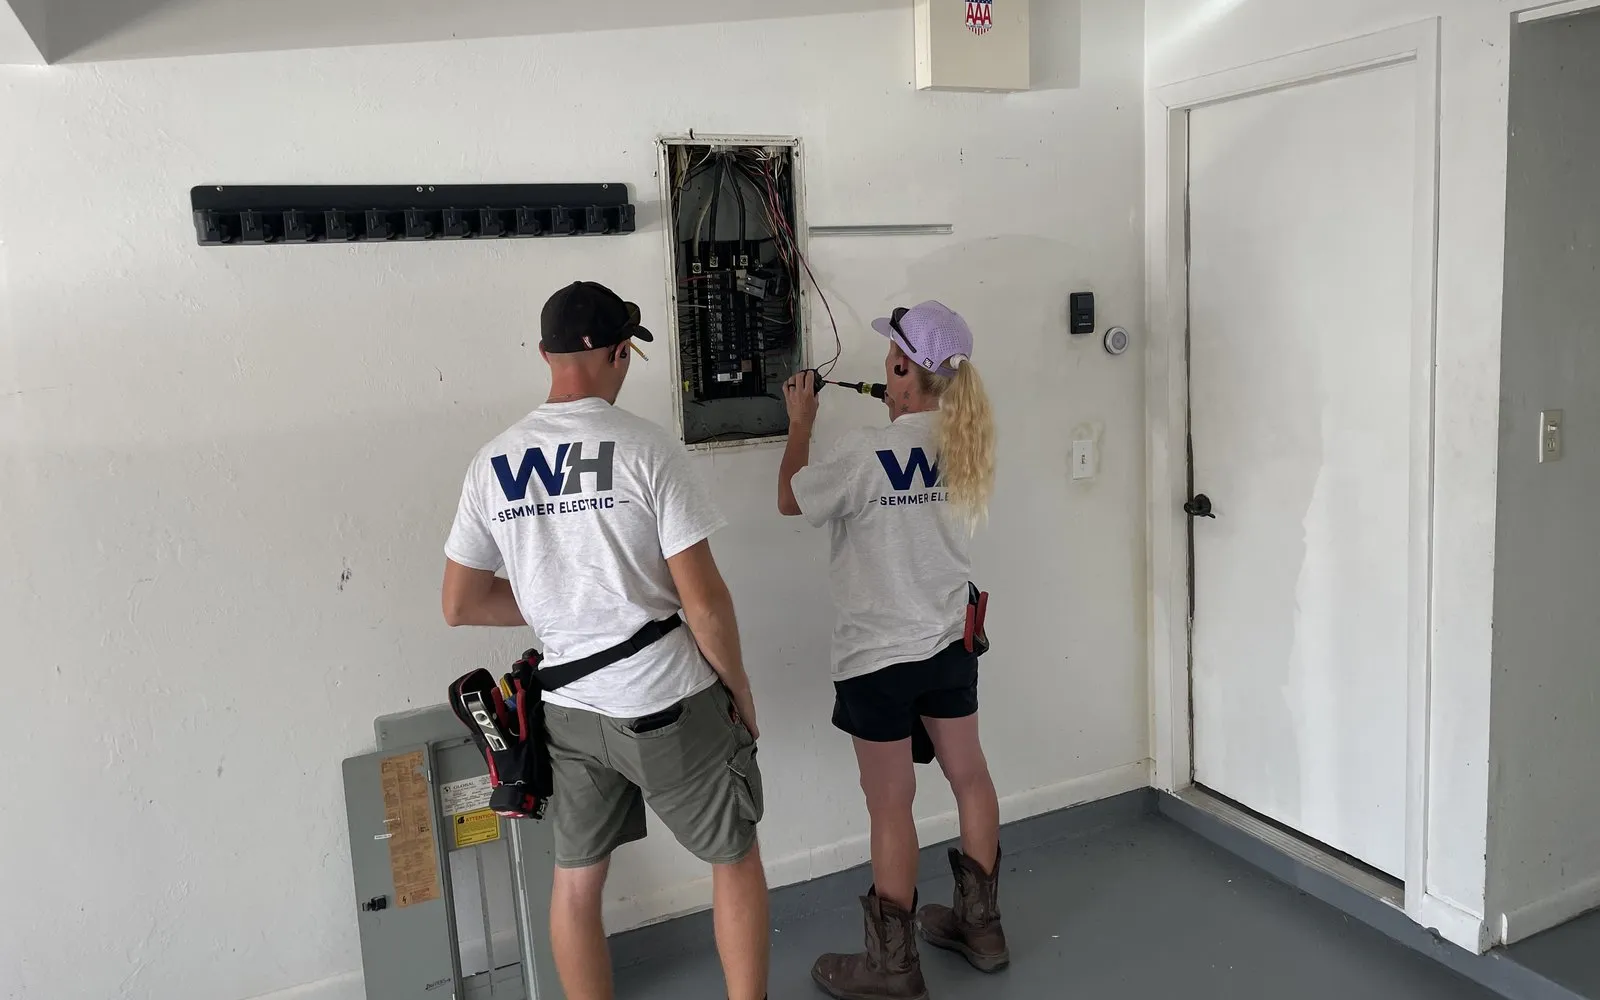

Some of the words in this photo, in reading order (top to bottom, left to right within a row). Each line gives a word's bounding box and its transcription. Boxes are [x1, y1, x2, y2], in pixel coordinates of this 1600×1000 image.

[966, 2, 992, 25] AAA
[490, 441, 616, 502] WH
[875, 446, 949, 491] W
[497, 502, 556, 523] SEMMER
[559, 496, 615, 514] ELECTRIC
[880, 493, 929, 506] SEMMER
